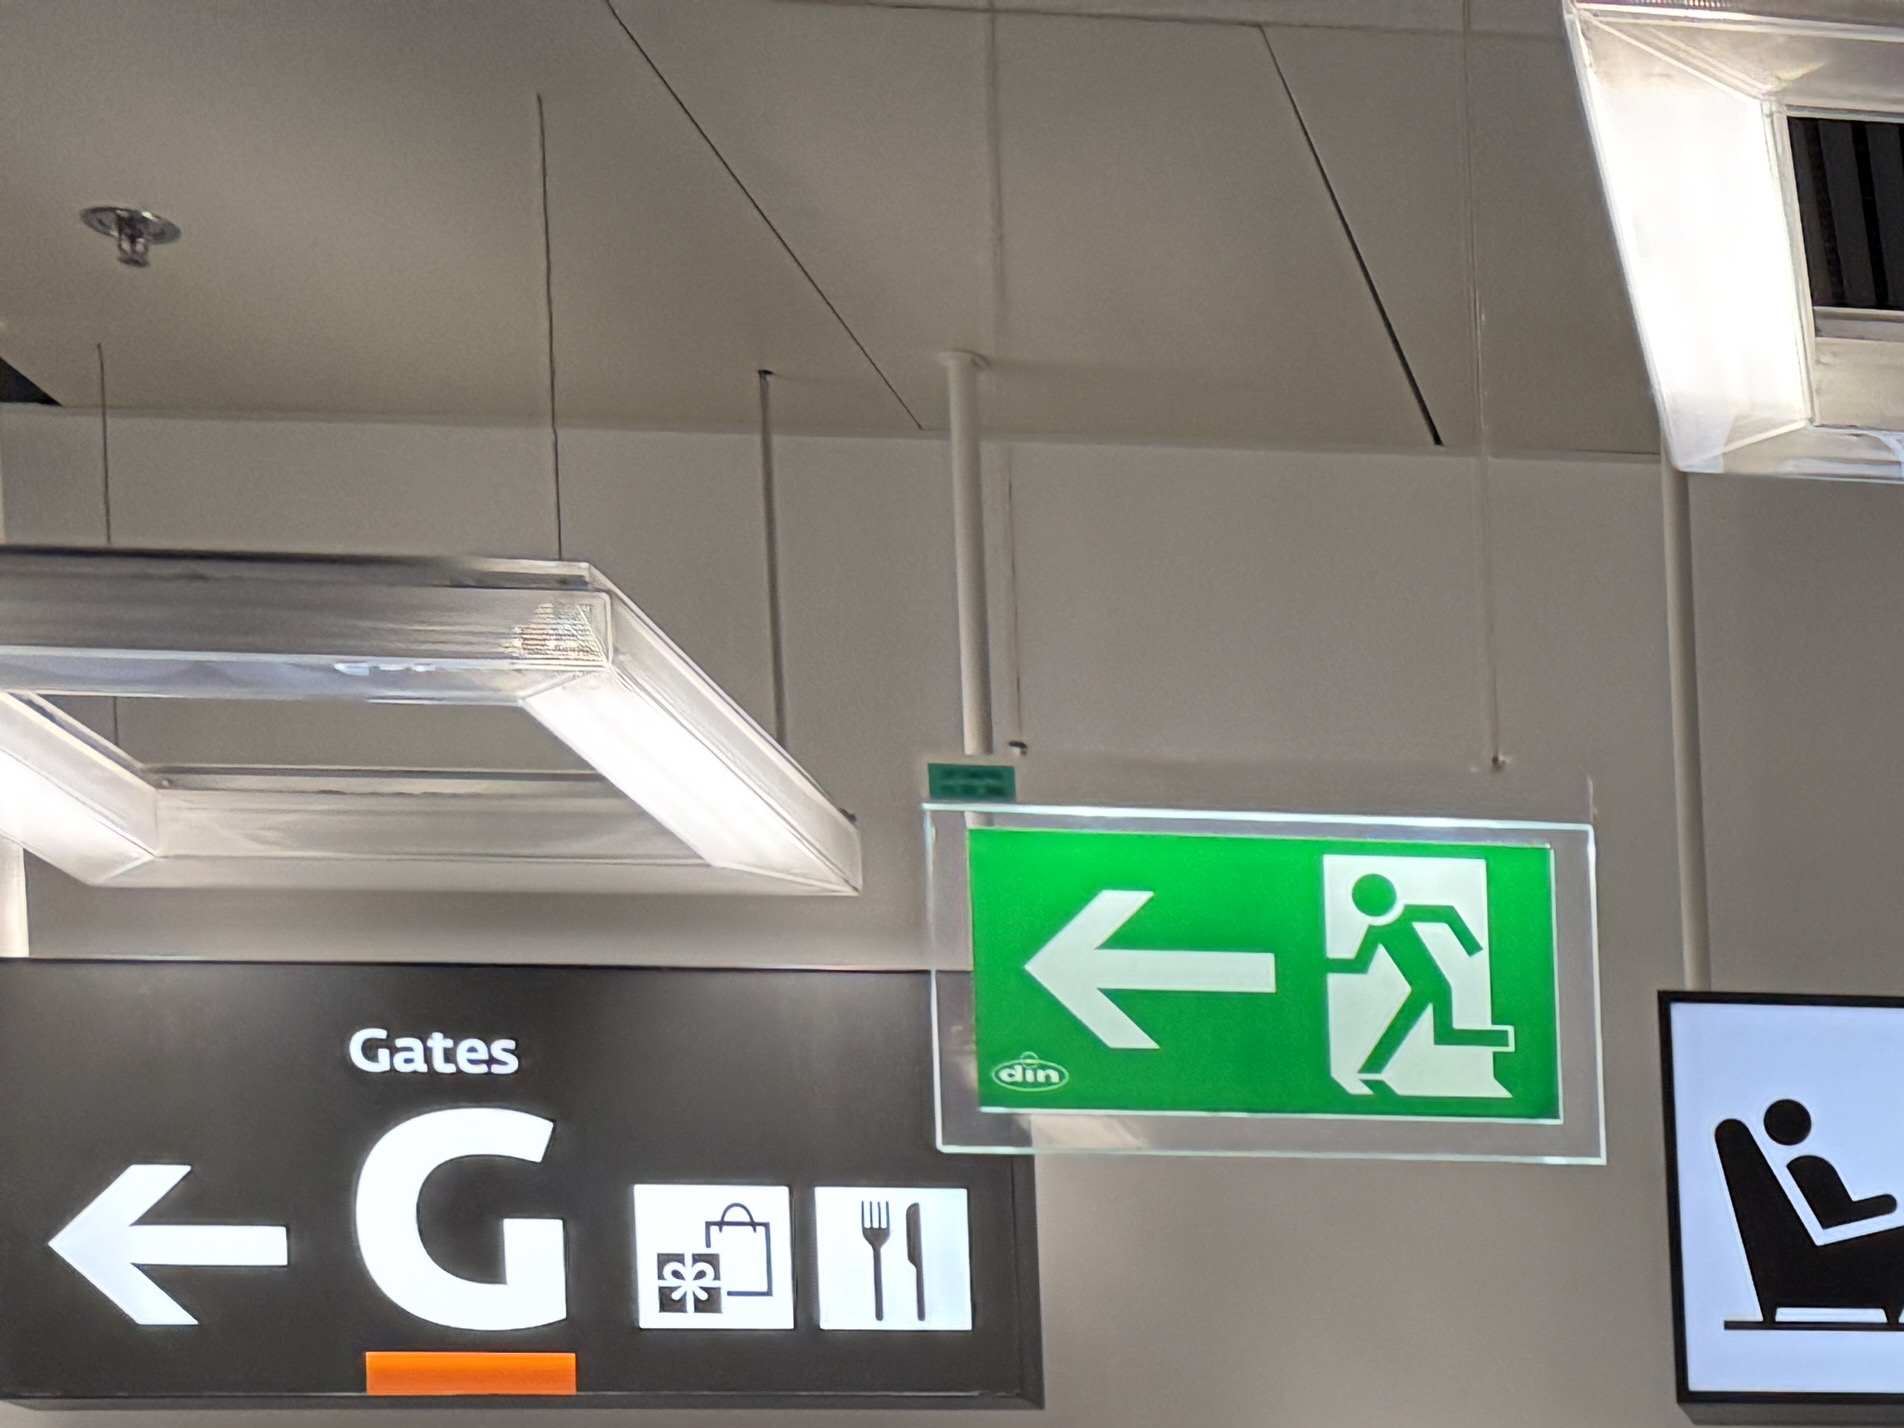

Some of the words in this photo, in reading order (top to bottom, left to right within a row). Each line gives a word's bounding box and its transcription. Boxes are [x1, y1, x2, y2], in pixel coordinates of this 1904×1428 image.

[349, 1028, 519, 1077] Gates
[998, 1064, 1060, 1084] din
[352, 1106, 569, 1332] G
